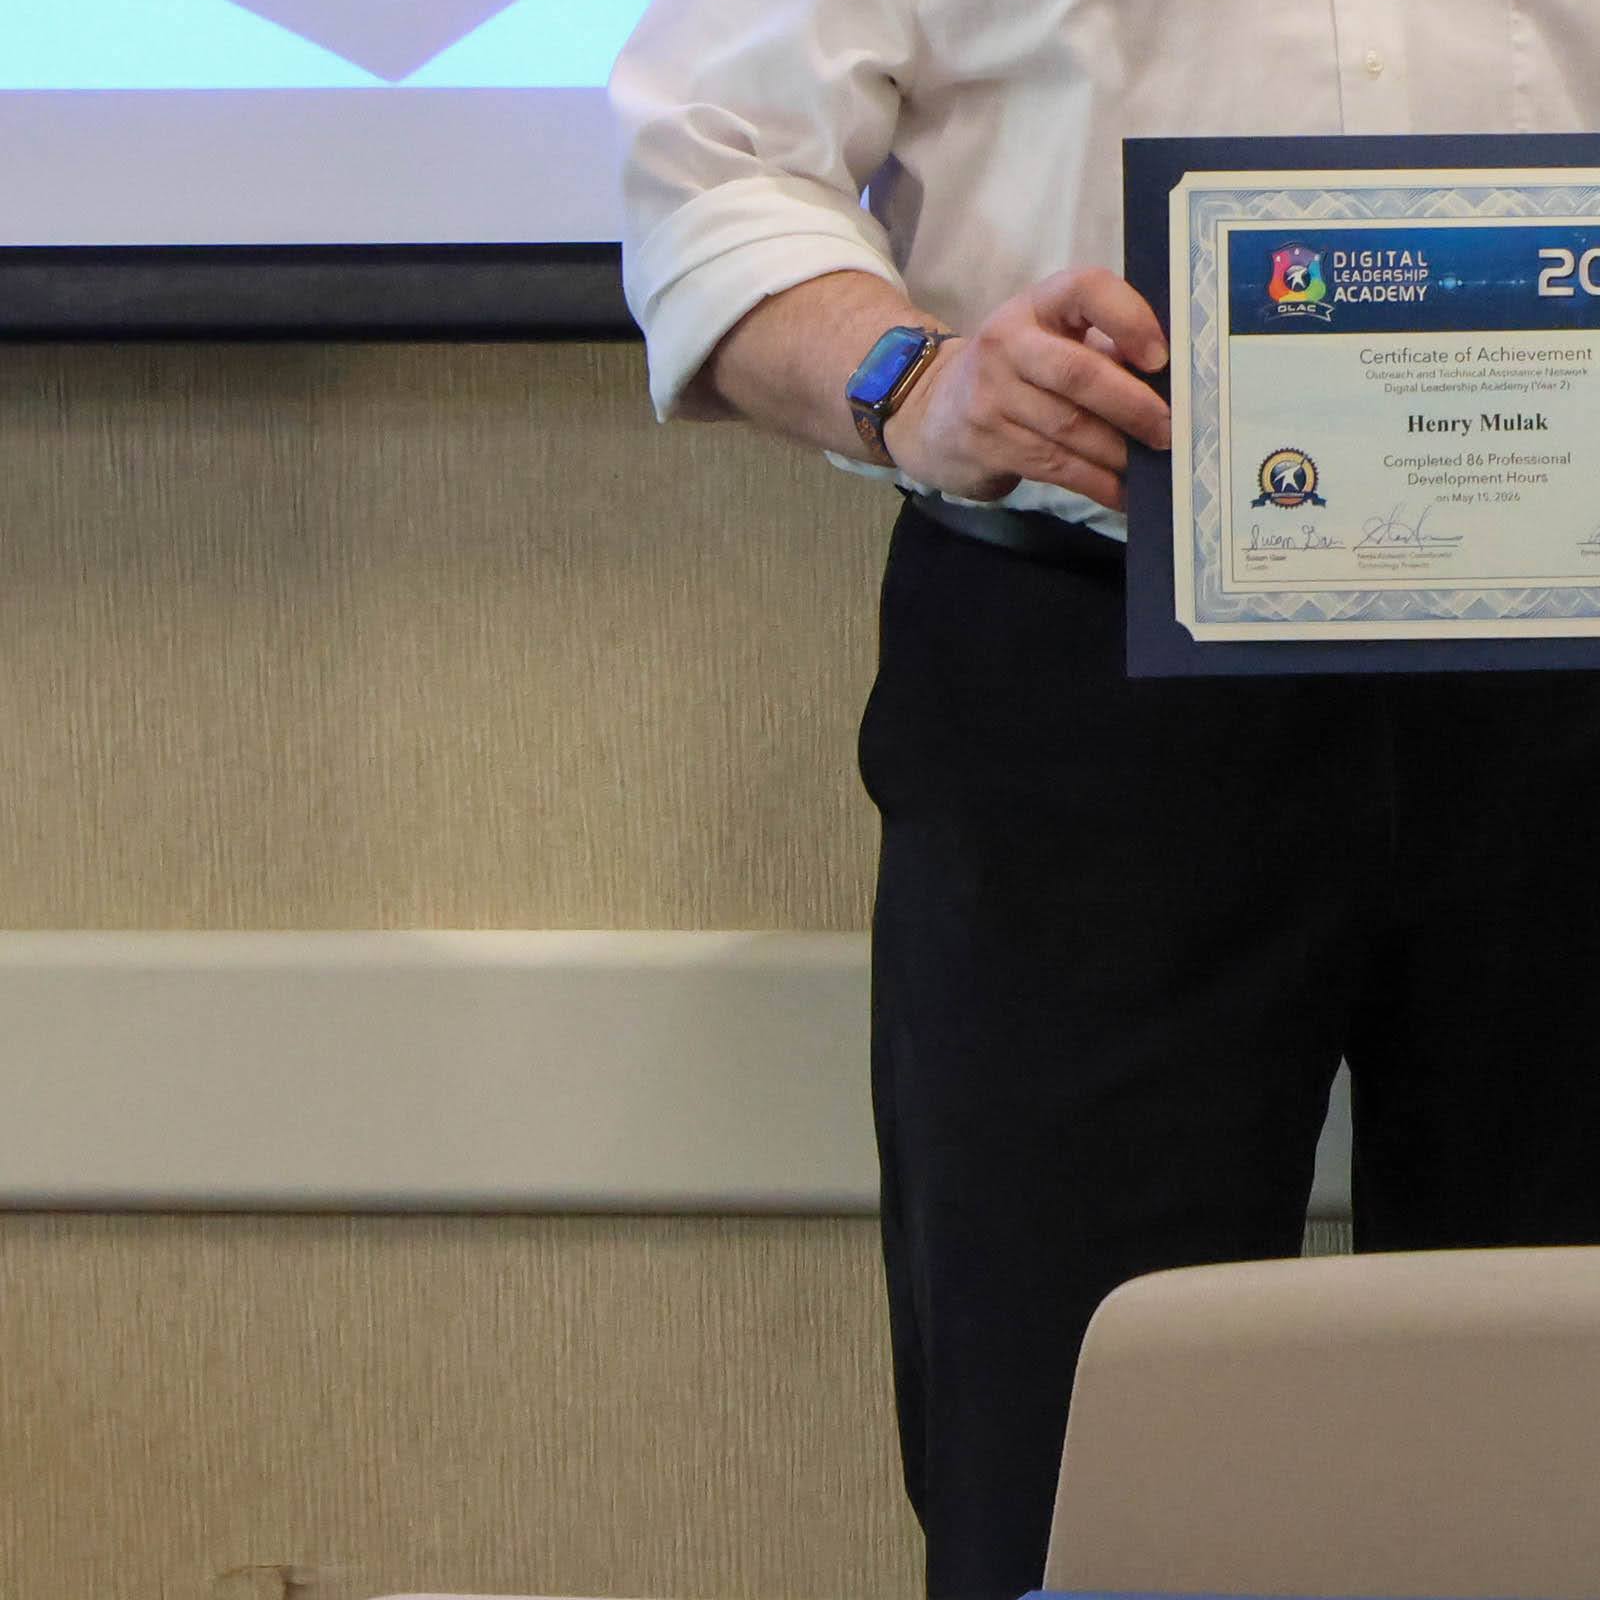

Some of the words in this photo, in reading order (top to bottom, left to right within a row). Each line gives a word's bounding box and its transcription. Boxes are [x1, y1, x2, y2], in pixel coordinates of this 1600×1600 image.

[1333, 250, 1428, 268] DIGITAL
[1333, 269, 1429, 283] LEADERSHIP
[1333, 285, 1428, 304] ACADEMY
[1359, 348, 1449, 365] Certificate
[1454, 347, 1473, 364] of
[1477, 347, 1593, 362] Achievement
[1365, 369, 1414, 380] Outreach
[1416, 369, 1436, 379] and
[1439, 368, 1486, 379] Technical
[1545, 366, 1588, 377] Network
[1384, 382, 1418, 395] Digital
[1420, 382, 1478, 394] Leadership
[1480, 381, 1529, 393] Academy
[1407, 415, 1473, 437] Henry
[1480, 413, 1549, 433] Mulak
[1383, 454, 1463, 471] Completed
[1466, 453, 1484, 465] 86
[1488, 451, 1572, 466] Professional
[1407, 472, 1503, 488] Development
[1506, 471, 1549, 484] Hours
[1452, 493, 1475, 504] May
